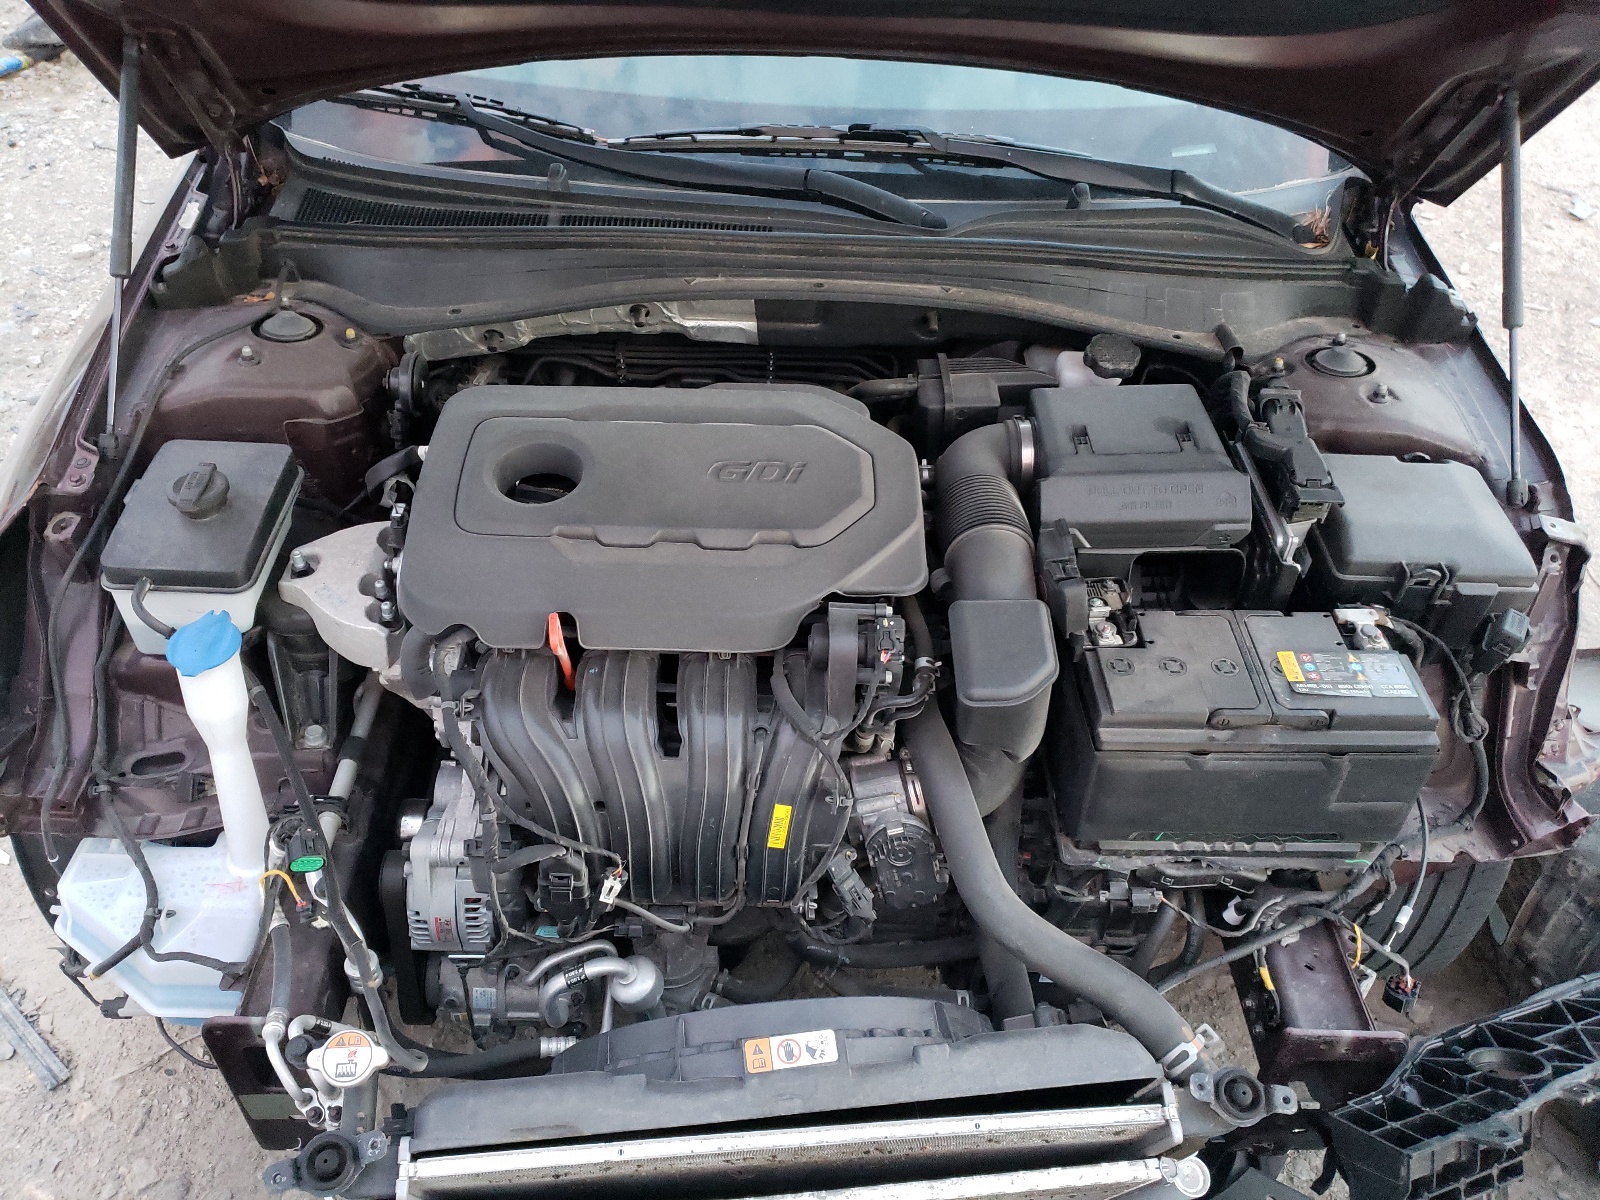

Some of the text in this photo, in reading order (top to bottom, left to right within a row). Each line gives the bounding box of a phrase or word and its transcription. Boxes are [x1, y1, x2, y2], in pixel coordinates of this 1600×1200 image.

[1086, 482, 1205, 497] PULL OUT TO OPEN
